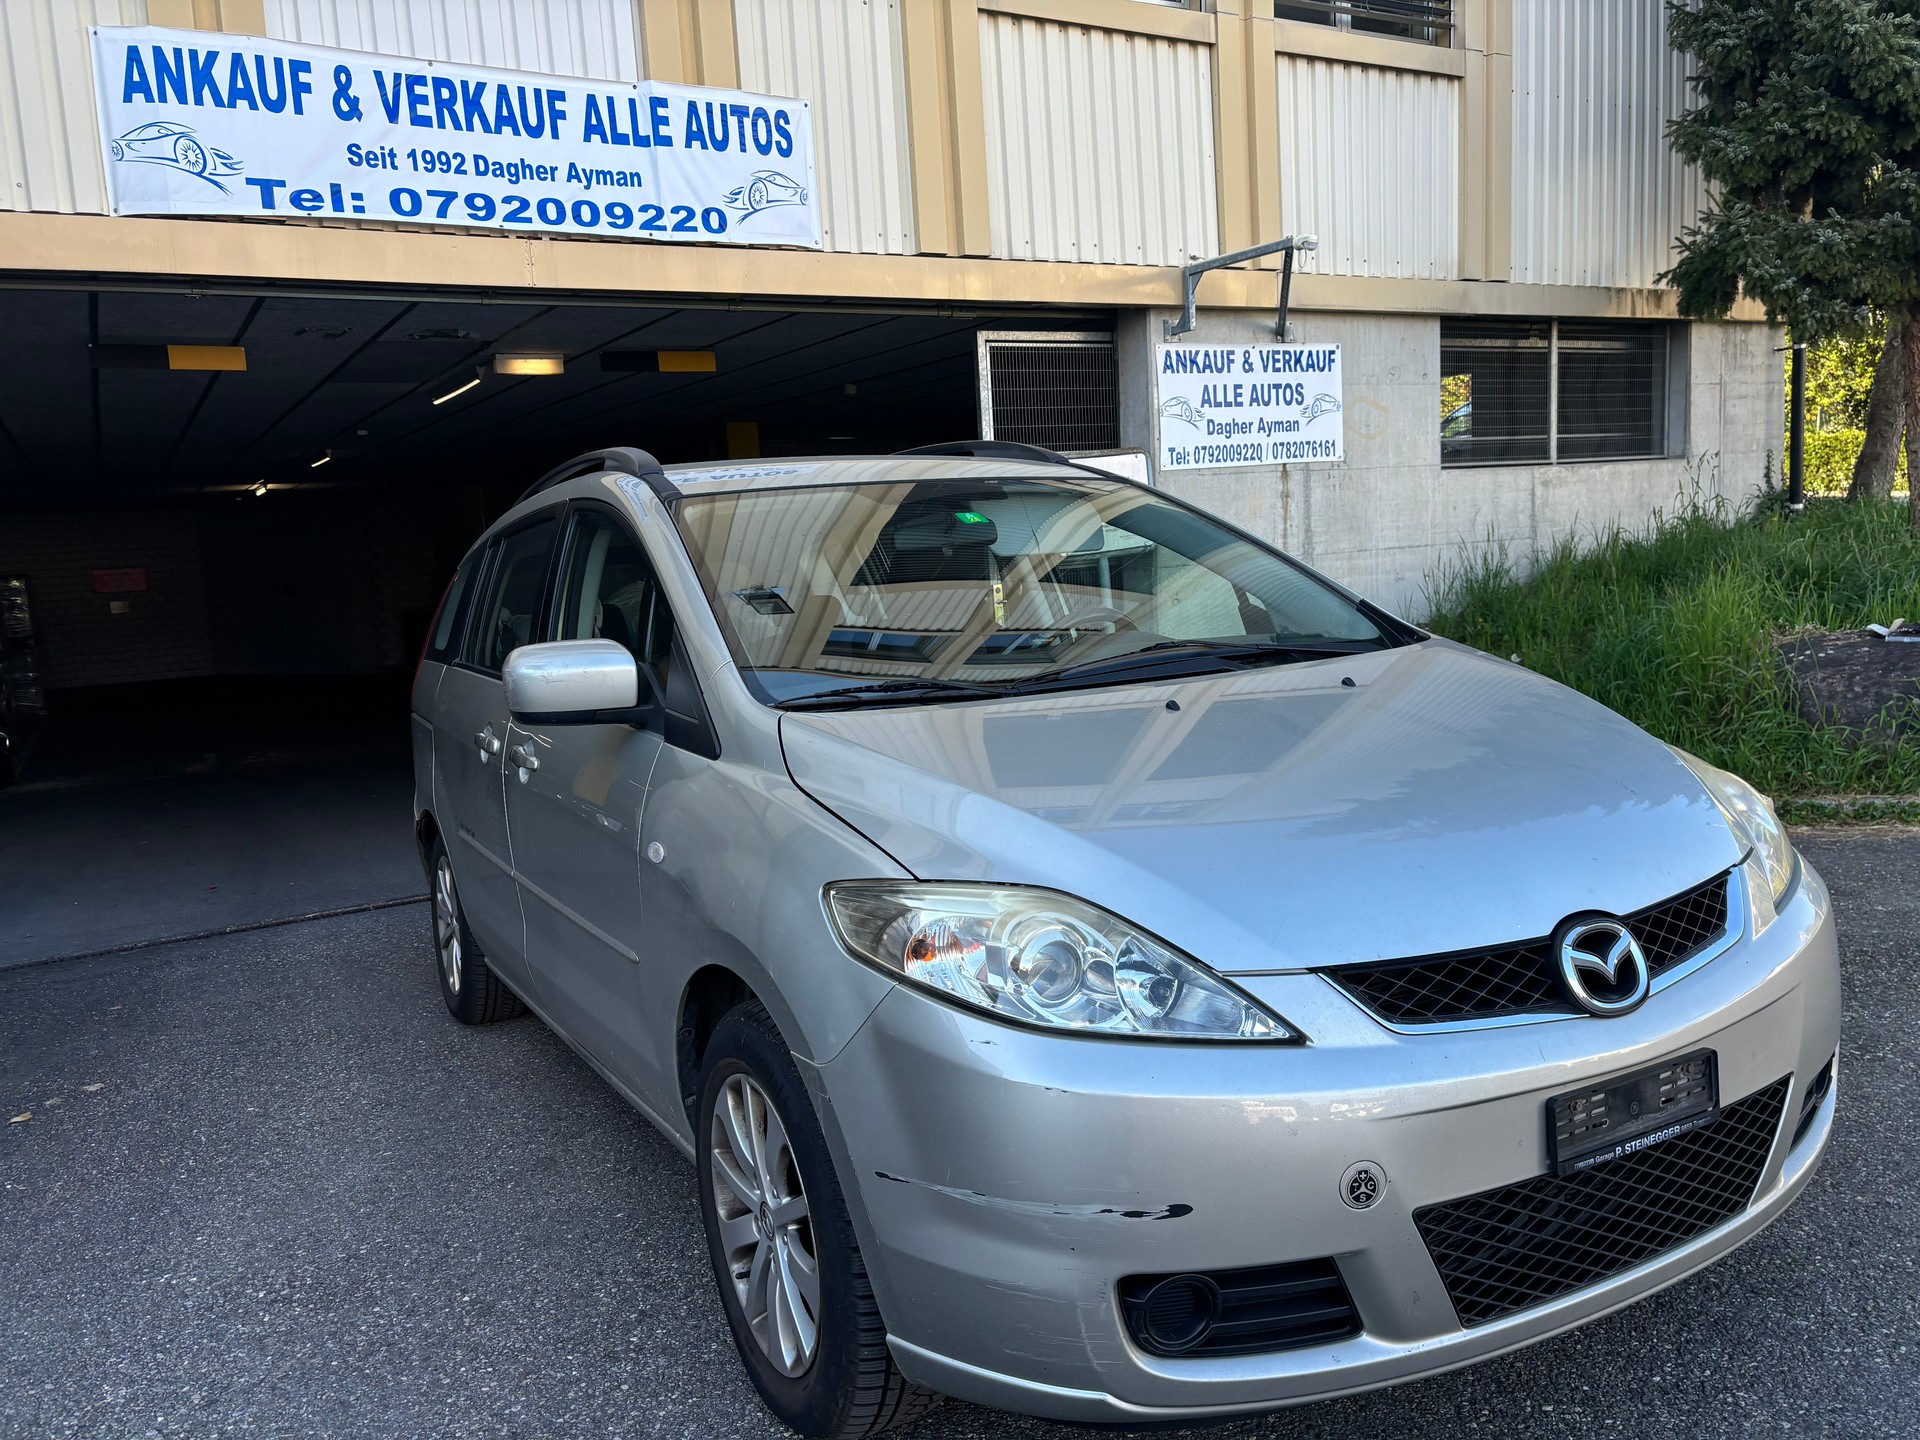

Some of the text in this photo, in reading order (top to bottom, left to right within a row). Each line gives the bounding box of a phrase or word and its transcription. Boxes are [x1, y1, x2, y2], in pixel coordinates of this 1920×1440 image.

[122, 44, 794, 159] ANKAUF & VERKAUF ALLE AUTOS
[347, 142, 643, 191] Seit 1992 Dagher Ayman
[245, 177, 728, 235] Tel: 0792009220
[1163, 349, 1336, 374] ANKAUF & VERKAUF
[1200, 382, 1305, 408] ALLE AUTOS
[1207, 417, 1300, 439] Dagher Ayman
[1168, 447, 1190, 466] Tel:
[1194, 442, 1263, 464] 0792009220
[1272, 439, 1336, 460] 0782076161
[1624, 1125, 1681, 1154] STEINEGGER
